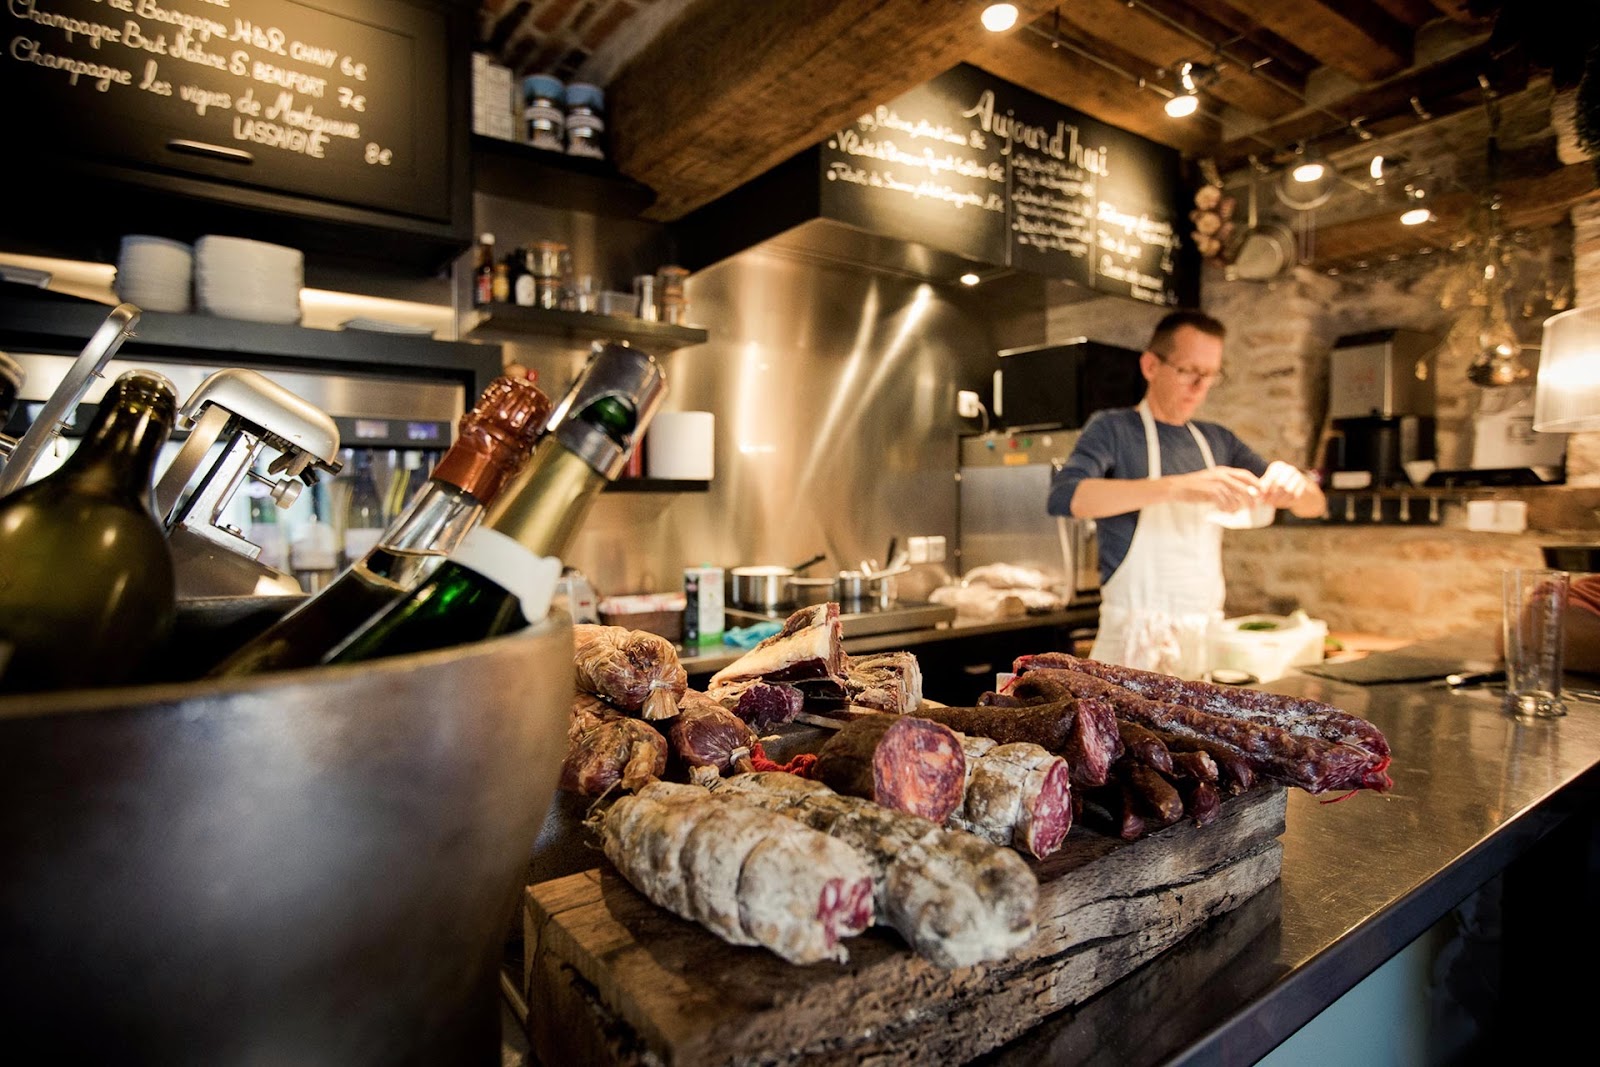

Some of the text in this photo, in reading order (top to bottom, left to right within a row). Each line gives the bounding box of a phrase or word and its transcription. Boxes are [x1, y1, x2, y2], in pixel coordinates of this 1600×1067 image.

[8, 0, 121, 49] Champagne
[121, 20, 168, 55] Brut
[252, 60, 328, 98] BEAUFORT
[337, 86, 367, 112] 7€
[10, 36, 132, 92] Champagne
[235, 88, 261, 116] de
[340, 55, 367, 81] 6€
[232, 115, 393, 166] LASSAIGNE 8€
[962, 89, 1109, 177] Aujourd'hui
